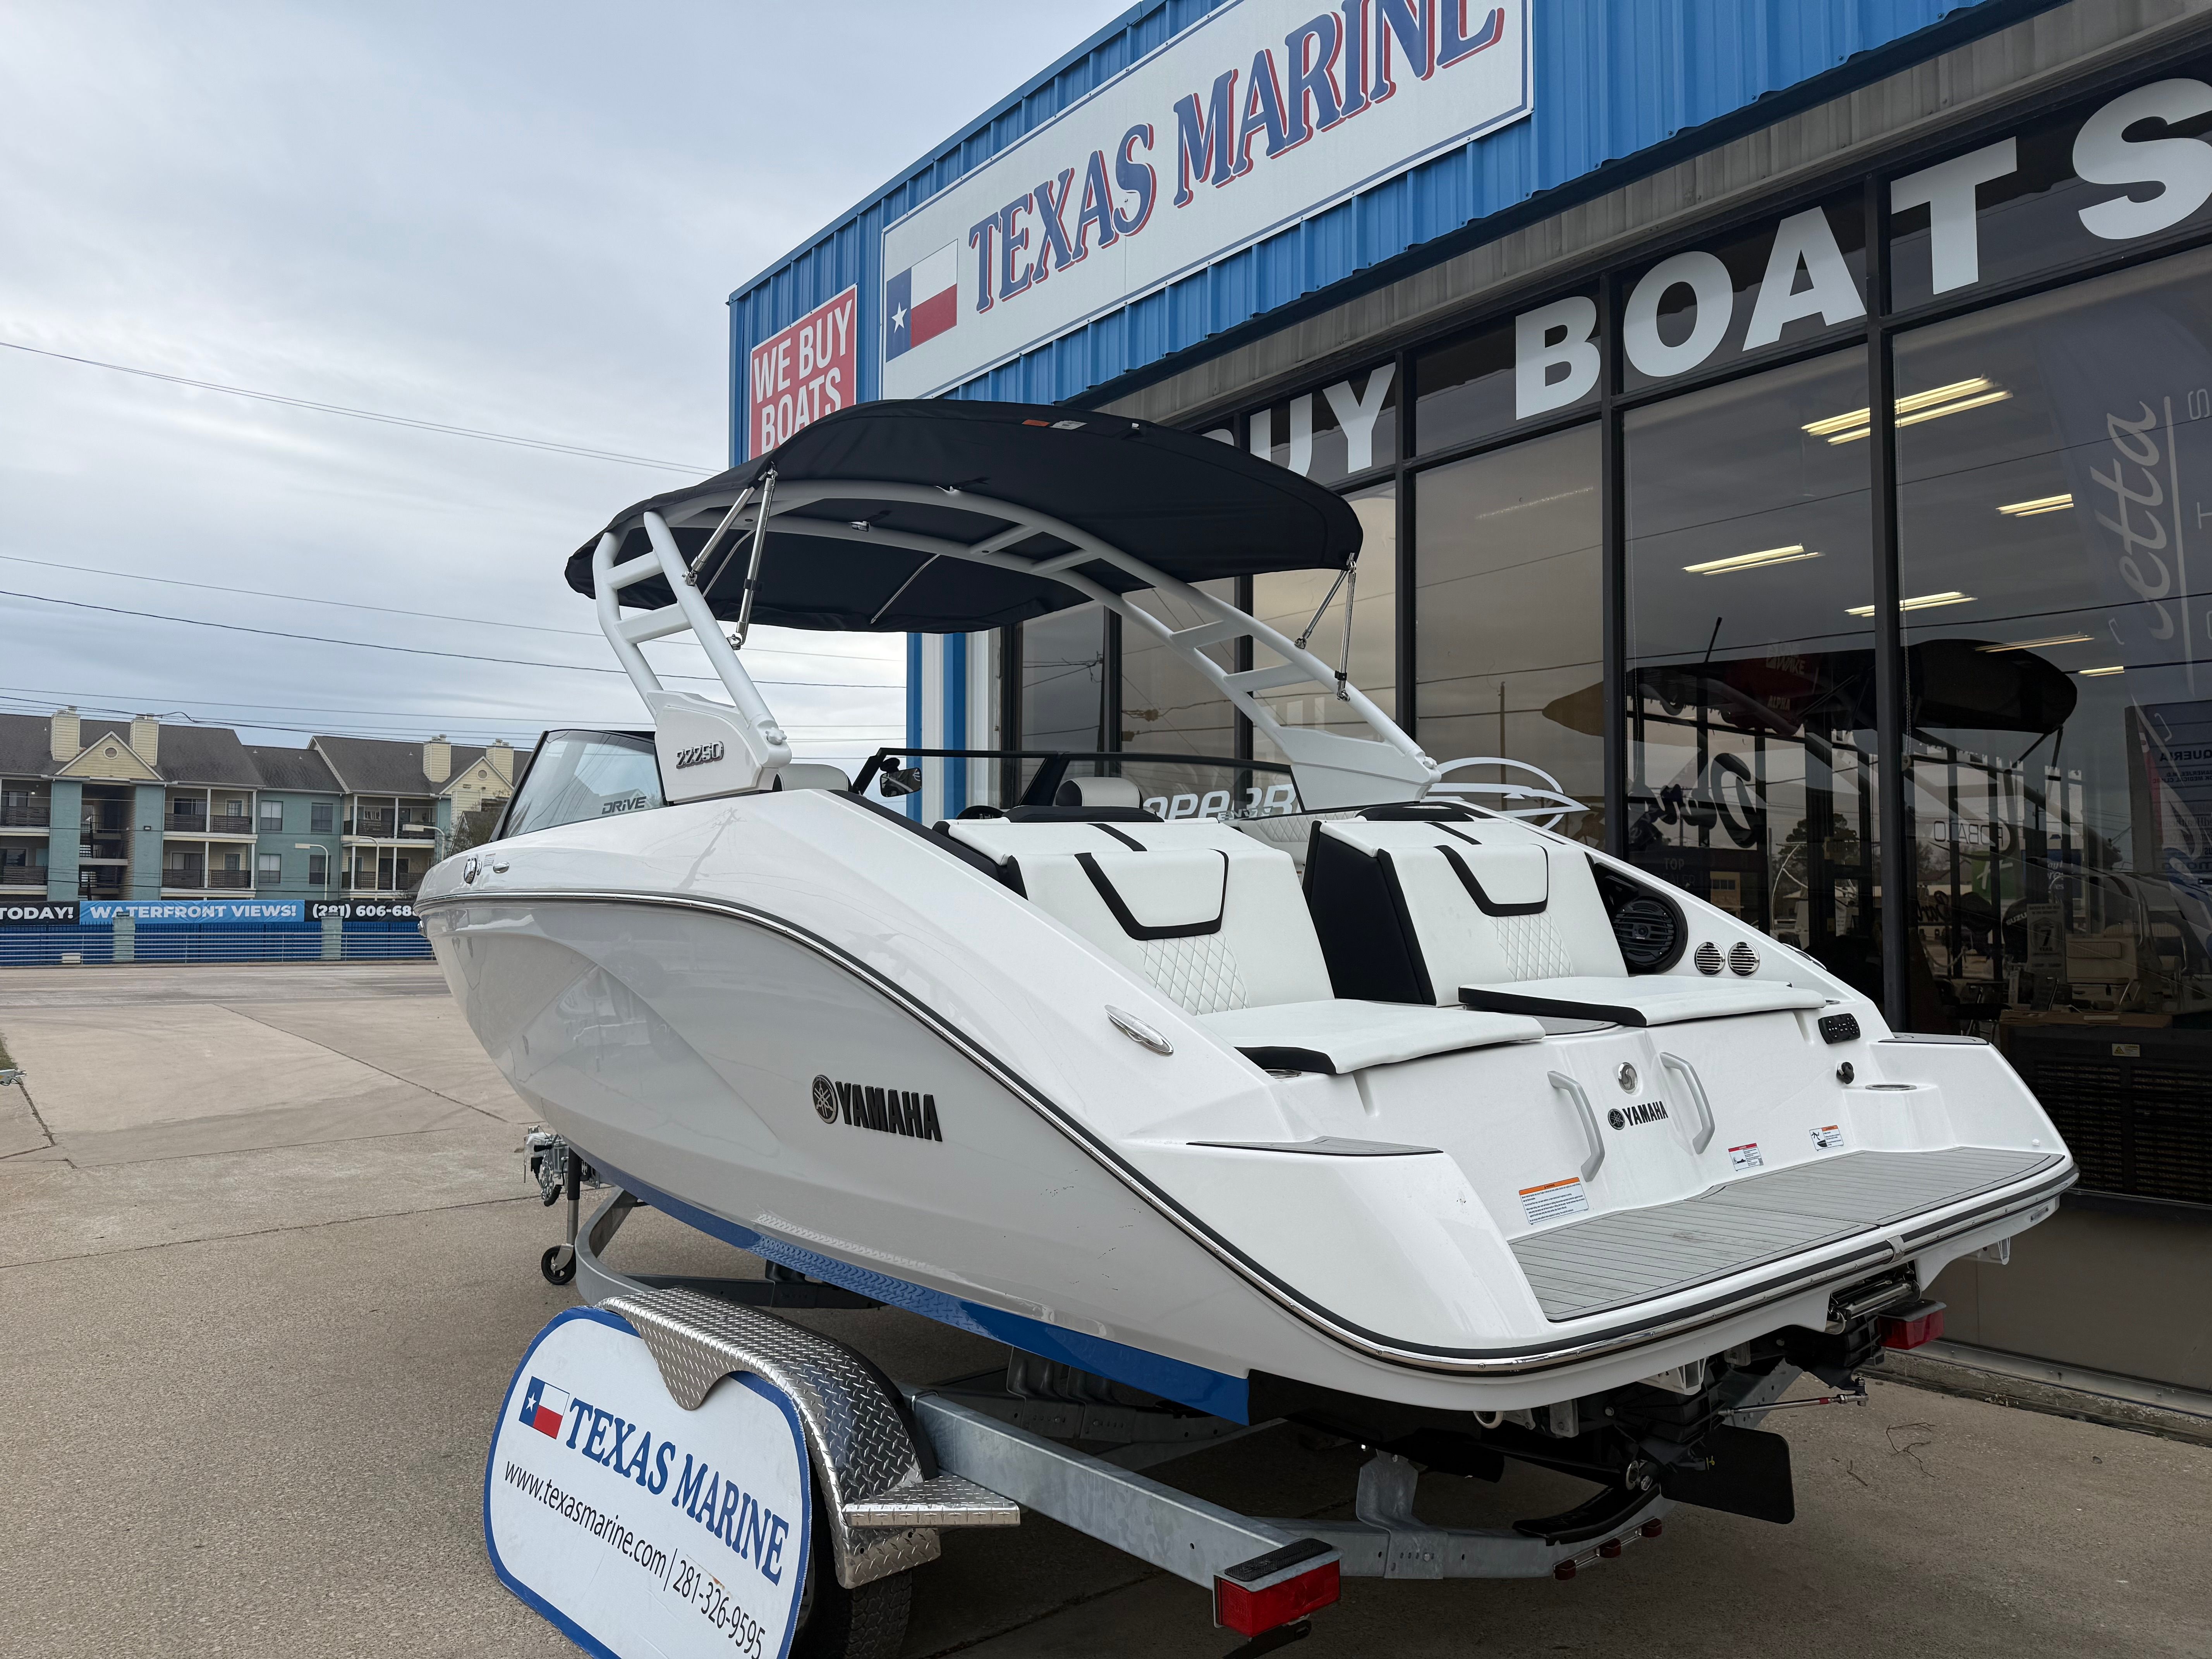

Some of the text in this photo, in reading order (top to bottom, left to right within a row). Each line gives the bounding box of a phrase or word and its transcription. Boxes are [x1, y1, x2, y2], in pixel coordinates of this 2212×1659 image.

[969, 123, 1156, 314] TEXAS
[1201, 77, 2212, 477] UY BOATS
[754, 299, 852, 404] WE BUY
[761, 368, 841, 455] BOATS
[0, 903, 417, 920] TODAY! WATERFRONT VIEWS! (281) 606-68
[835, 1081, 943, 1142] YAMAHA
[1622, 1101, 1669, 1126] YAMAHA
[566, 1397, 789, 1587] TEXAS MARINE
[505, 1461, 667, 1579] www.texasmarine.com
[672, 1559, 766, 1659] 281-326-9595
